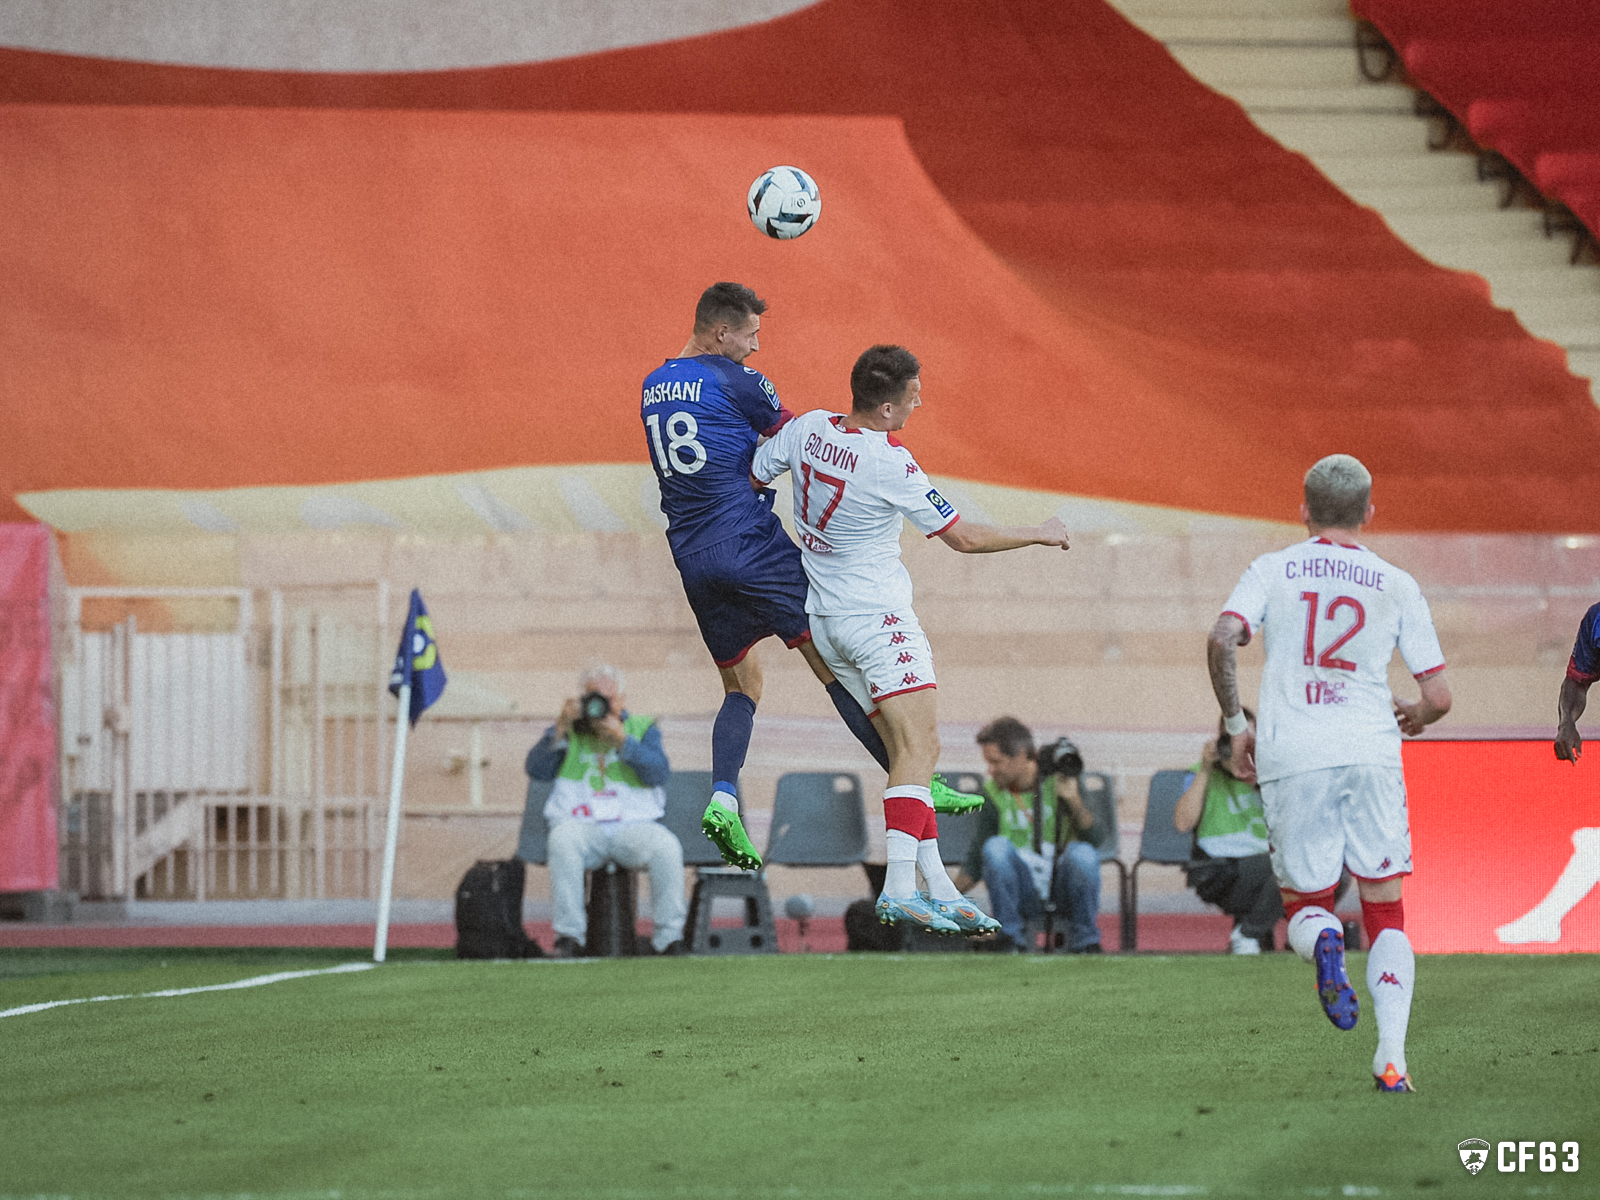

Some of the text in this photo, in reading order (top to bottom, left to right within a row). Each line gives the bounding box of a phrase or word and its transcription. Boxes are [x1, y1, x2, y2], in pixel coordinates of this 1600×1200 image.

[646, 411, 708, 478] 18
[801, 460, 846, 532] 17
[1300, 591, 1366, 672] 12
